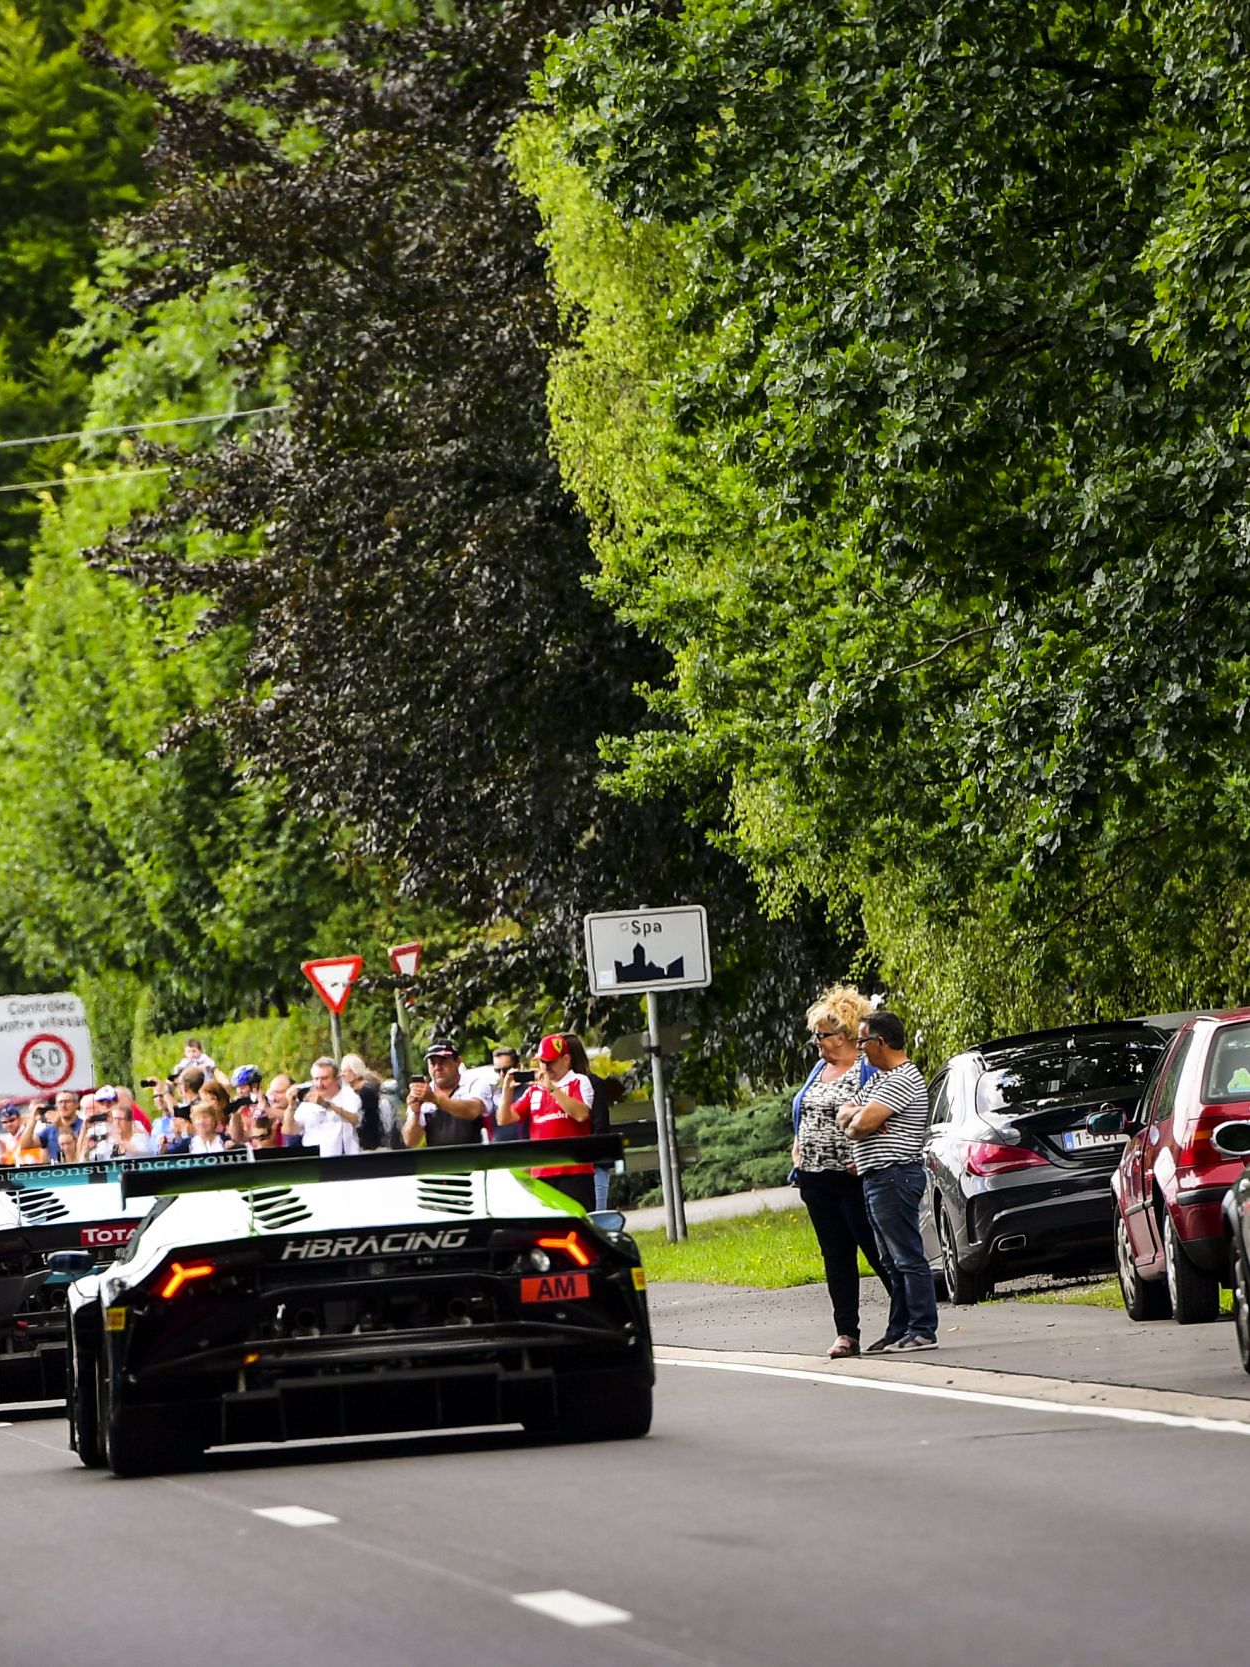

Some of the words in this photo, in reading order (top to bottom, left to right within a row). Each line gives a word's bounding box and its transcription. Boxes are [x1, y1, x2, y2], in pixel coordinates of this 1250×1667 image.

[632, 920, 662, 937] Spa
[31, 1048, 62, 1068] 50
[82, 1227, 138, 1243] TOTA
[536, 1277, 576, 1300] AM
